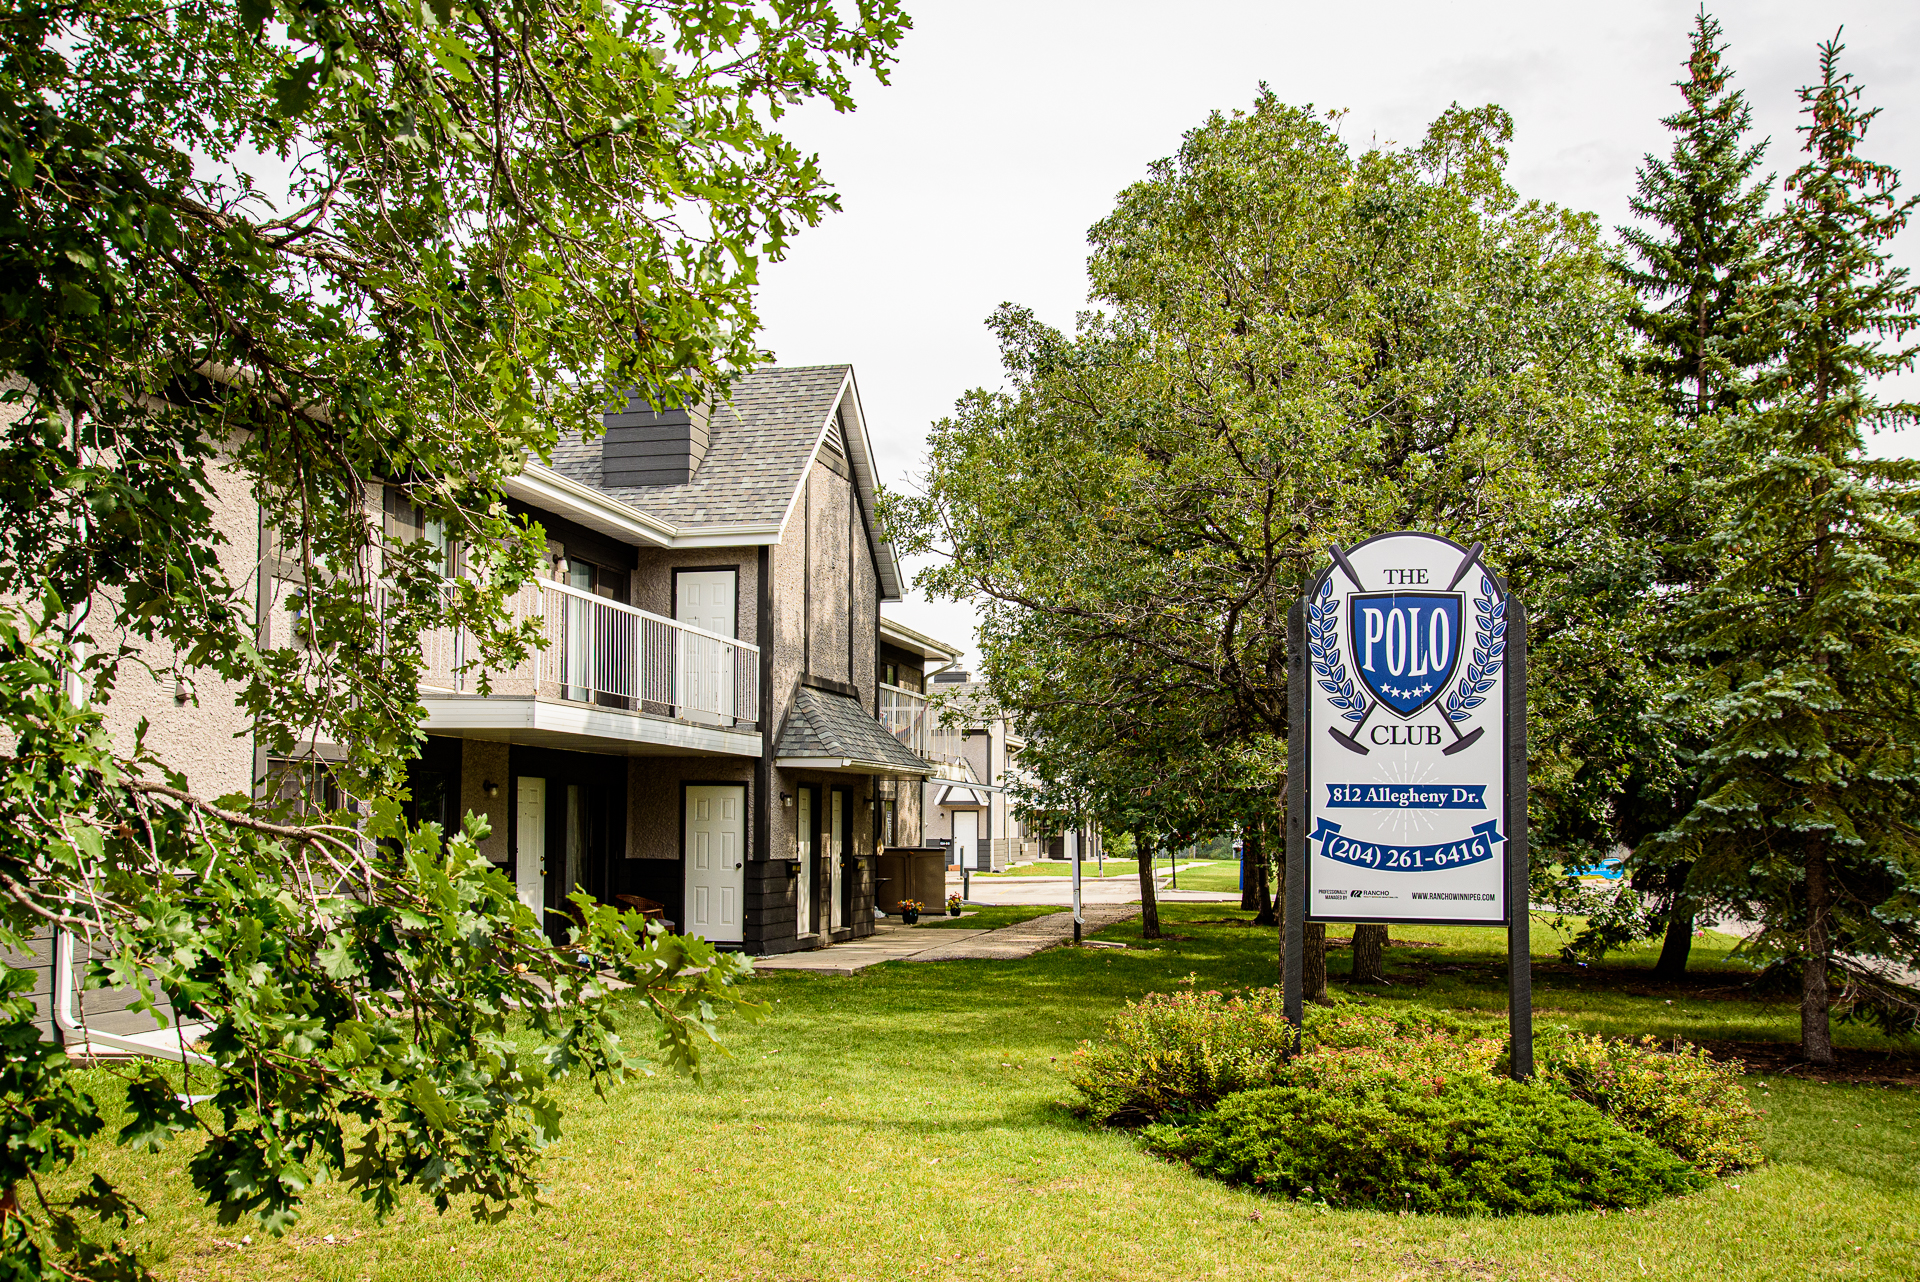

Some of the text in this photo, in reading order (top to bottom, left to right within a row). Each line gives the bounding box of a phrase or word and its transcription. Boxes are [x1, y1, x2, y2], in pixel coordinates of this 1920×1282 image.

[1383, 568, 1429, 585] THE
[1362, 607, 1450, 677] POLO
[1370, 725, 1442, 746] CLUB
[1333, 787, 1480, 808] 812 Allegheny Dr.
[1328, 837, 1485, 868] (204) 261-6416
[1411, 892, 1496, 901] WWW.RANCHOWINNIPEG.COM
